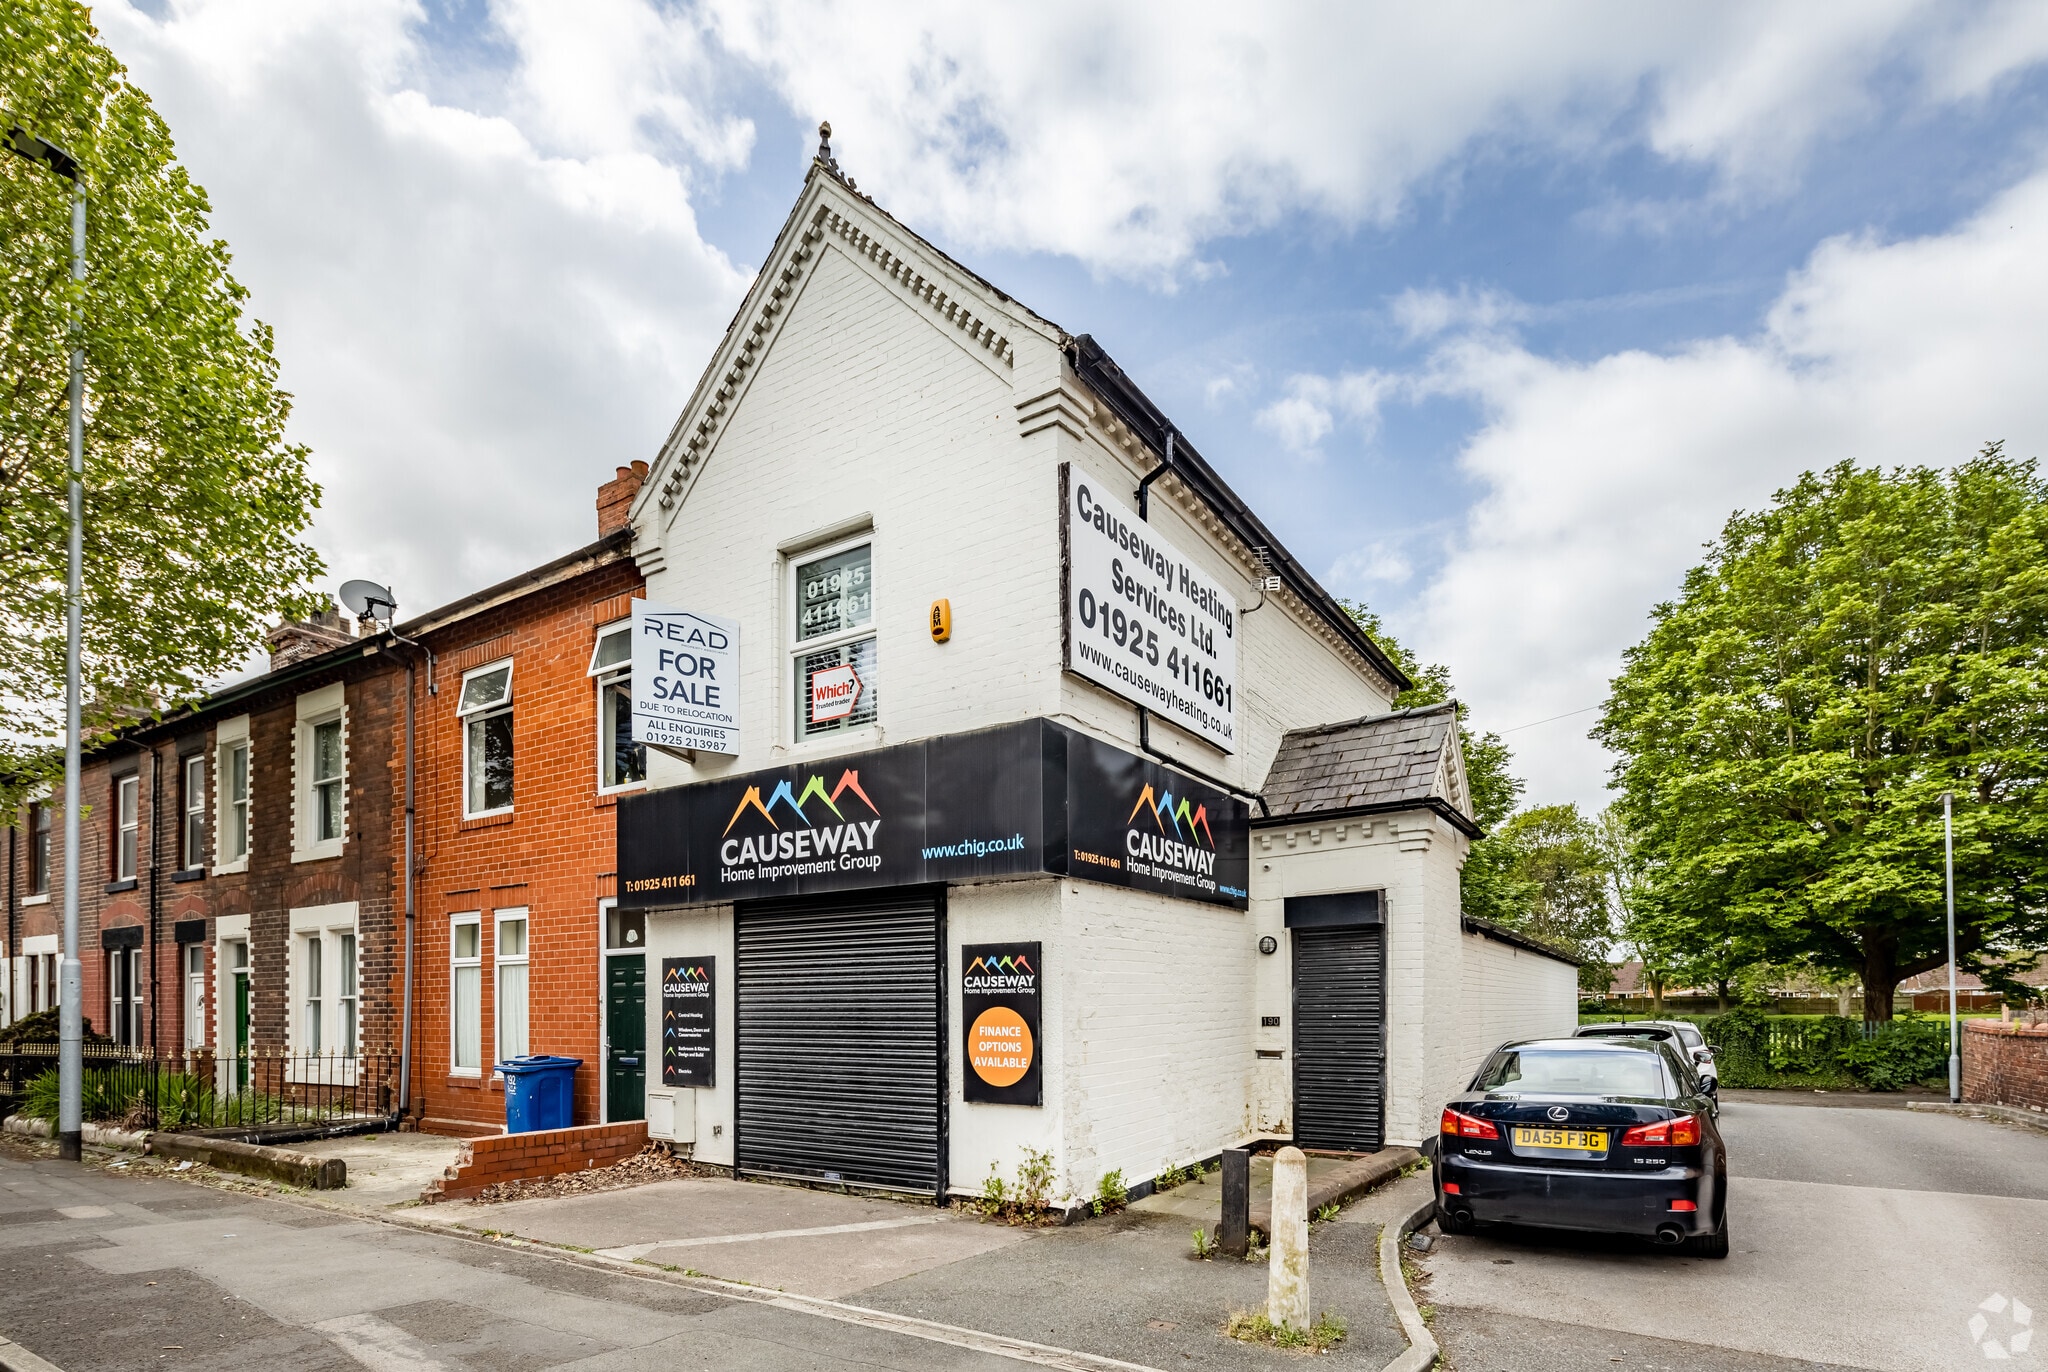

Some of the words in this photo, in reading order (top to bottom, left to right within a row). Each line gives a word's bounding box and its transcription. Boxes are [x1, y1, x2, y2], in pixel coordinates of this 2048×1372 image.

[1077, 484, 1174, 592] Causeway
[1179, 563, 1232, 638] Heating
[1112, 558, 1186, 637] Services
[1191, 614, 1216, 660] Ltd.
[644, 618, 728, 650] READ
[1079, 588, 1159, 666] 01925
[1166, 646, 1232, 713] 411661
[659, 648, 716, 680] FOR
[653, 676, 720, 708] SALE
[816, 679, 855, 702] Which?
[1078, 640, 1233, 740] www.causewayheating.co.uk
[640, 701, 660, 712] DUE
[662, 704, 676, 714] TO
[677, 707, 732, 723] RELOCATION
[816, 700, 834, 710] Trusted
[835, 697, 850, 708] trader
[648, 720, 666, 731] ALL
[669, 723, 726, 740] ENQUIRIES
[646, 732, 682, 746] 01925
[686, 736, 727, 752] 213987
[721, 820, 881, 866] CAUSEWAY
[922, 833, 1024, 860] www.chig.co.uk
[1126, 828, 1216, 876] CAUSEWAY
[721, 868, 754, 882] Home
[758, 858, 836, 882] Improvement
[840, 854, 881, 872] Group
[1100, 855, 1110, 868] 411
[1110, 858, 1120, 869] 661
[662, 876, 677, 888] 411
[679, 874, 696, 886] 661
[1126, 856, 1150, 876] Home
[1152, 862, 1196, 886] Improvement
[1196, 874, 1216, 894] Group
[664, 982, 710, 992] CAUSEWAY
[964, 975, 1035, 988] CAUSEWAY
[981, 987, 1016, 996] Improvement
[1017, 986, 1036, 995] Group
[980, 1026, 1021, 1036] FINANCE
[1263, 1018, 1279, 1026] 190
[979, 1042, 1022, 1052] OPTIONS
[974, 1057, 1027, 1068] AVAILABLE
[1522, 1130, 1563, 1145] DA55
[1567, 1132, 1599, 1148] FBG
